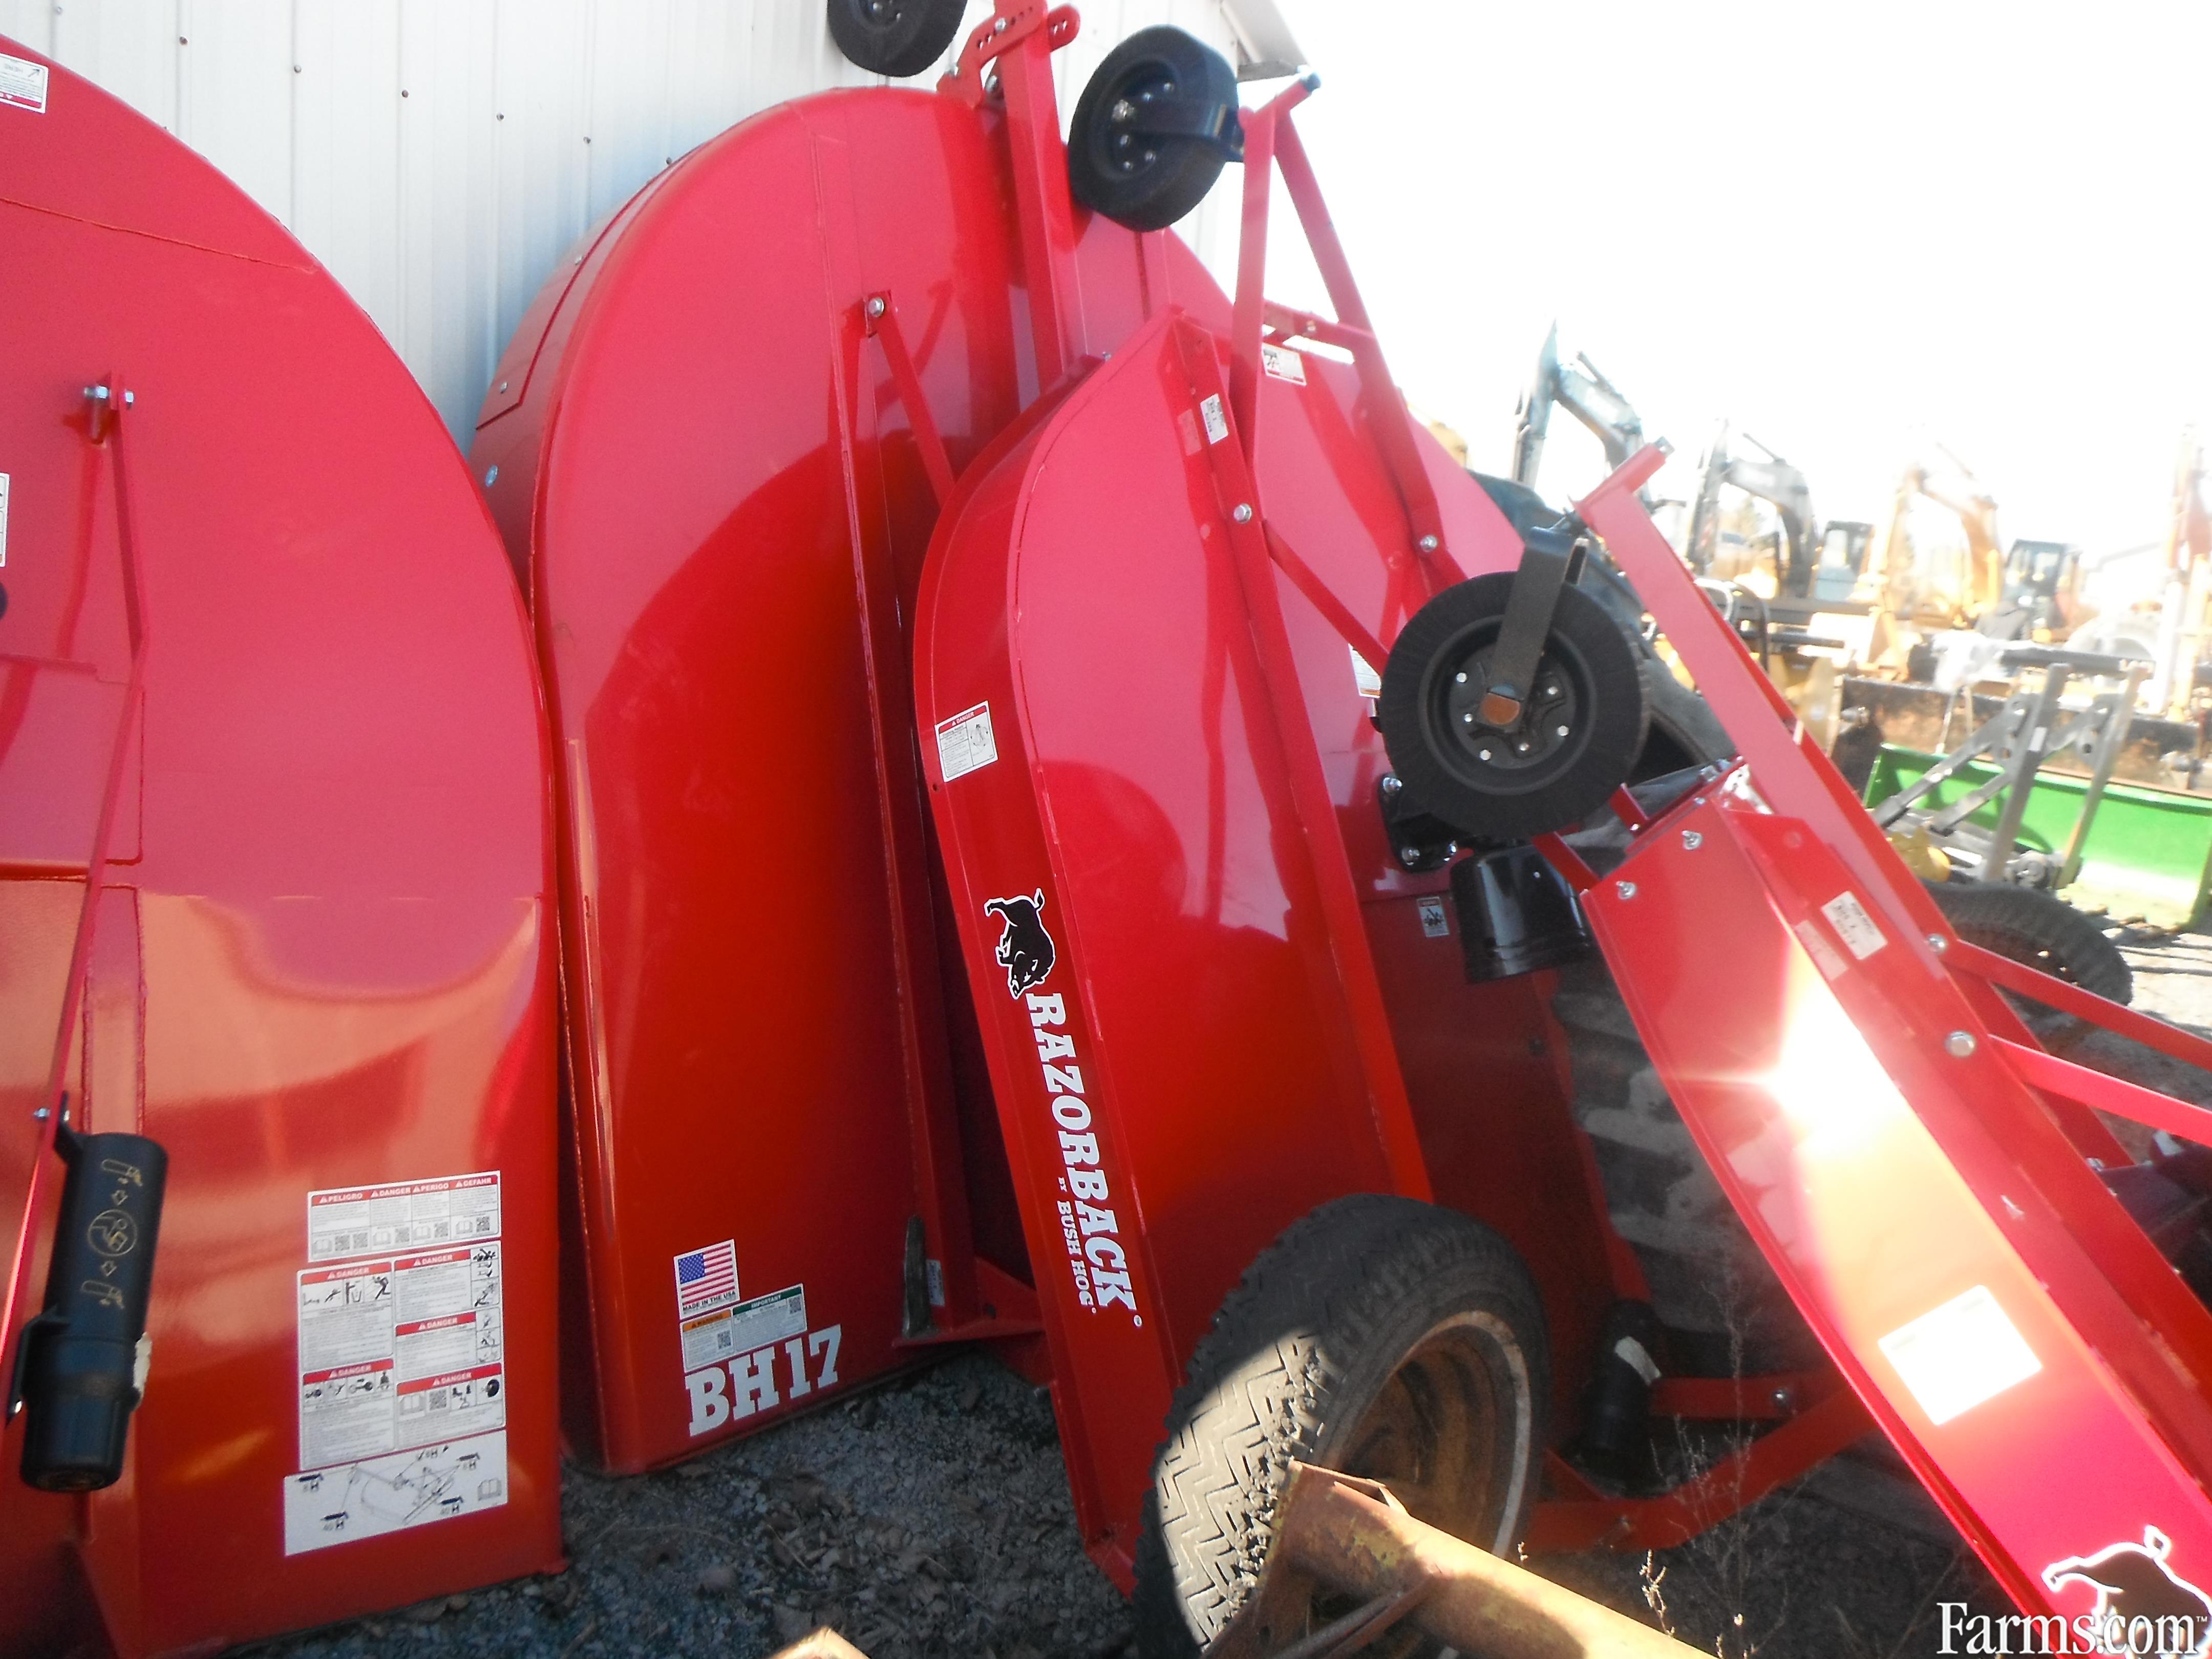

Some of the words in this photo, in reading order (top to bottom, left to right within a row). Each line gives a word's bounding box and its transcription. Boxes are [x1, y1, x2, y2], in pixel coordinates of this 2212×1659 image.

[1026, 993, 1137, 1311] RAZORBACK
[420, 1182, 449, 1192] PERIGO
[462, 1177, 492, 1187] GEFAHR
[1058, 1177, 1068, 1193] BY
[328, 1193, 363, 1202] PELIGRO
[379, 1187, 411, 1197] DANGER
[1057, 1200, 1082, 1255] BUSH
[422, 1254, 453, 1264] DANGER
[336, 1267, 370, 1278] DANGER
[1071, 1260, 1094, 1306] HOG
[751, 1293, 782, 1309] IMPORTANT
[683, 1303, 699, 1311] MADE
[427, 1317, 458, 1329] DANGER
[441, 1372, 472, 1383] DANGER
[685, 1324, 842, 1437] BH17
